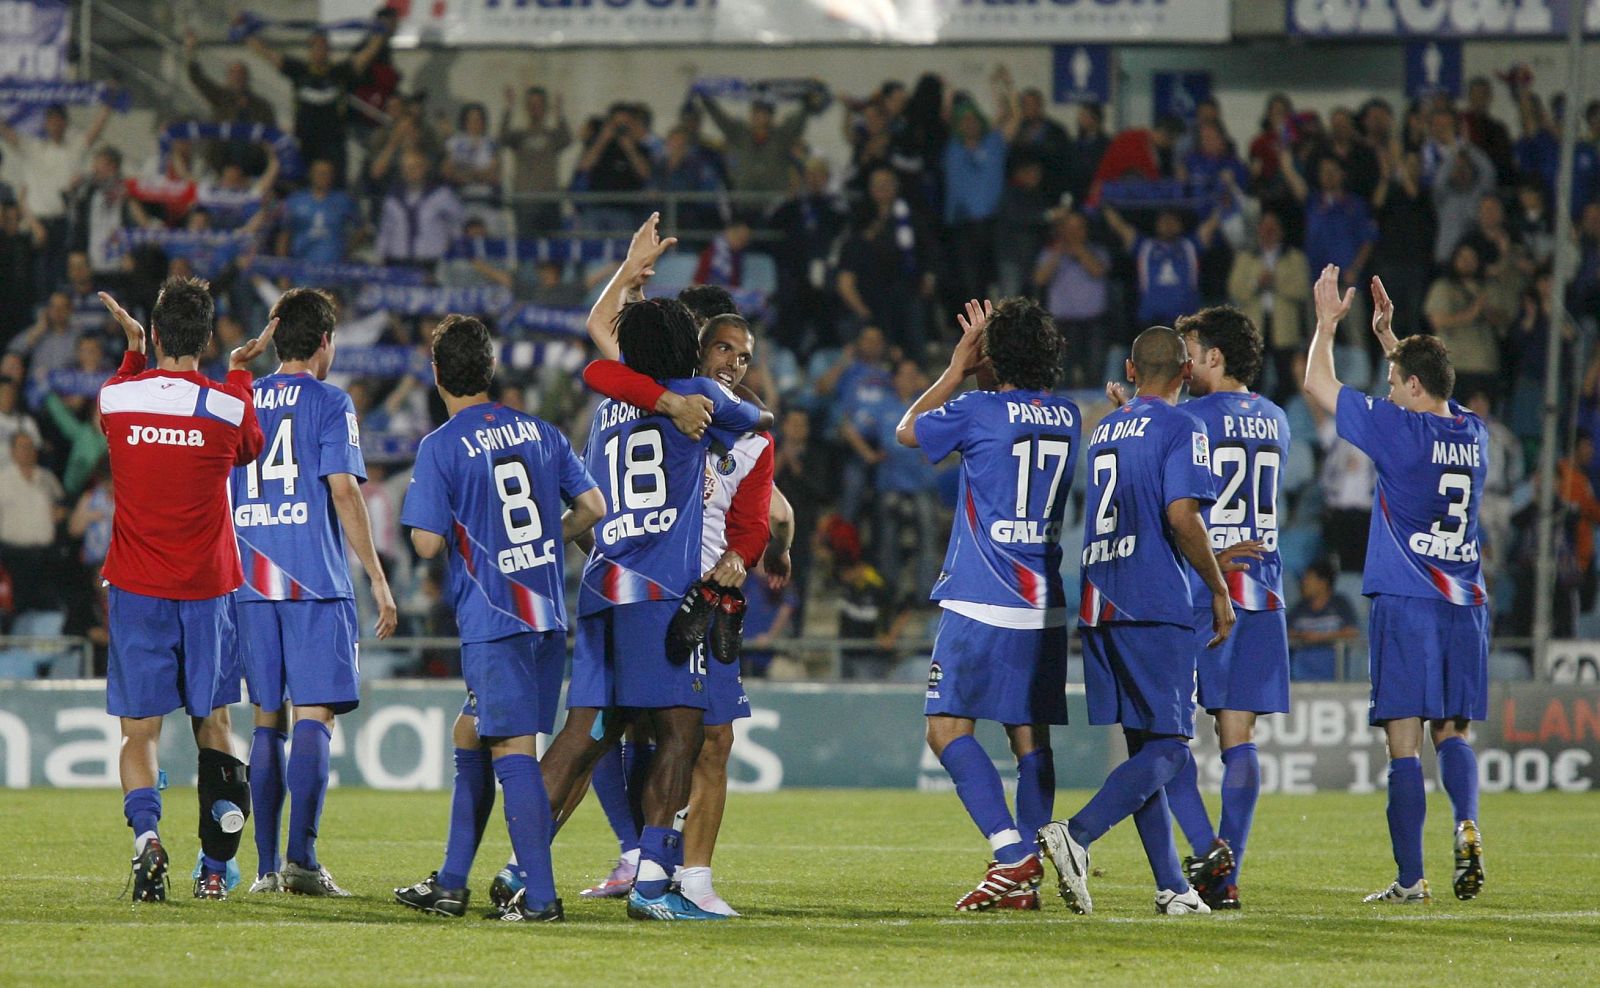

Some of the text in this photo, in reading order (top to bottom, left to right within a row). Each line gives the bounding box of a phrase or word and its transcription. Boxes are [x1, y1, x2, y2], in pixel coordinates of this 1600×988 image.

[253, 386, 301, 409] MANU
[1007, 401, 1073, 427] PAREJO
[1111, 417, 1151, 441] DIAZ
[1431, 437, 1480, 467] MANÉ
[604, 429, 667, 513] 18
[1012, 440, 1069, 519] 17
[1094, 454, 1118, 535] 2
[1210, 447, 1280, 529] 20
[235, 502, 308, 527] GALCO
[494, 461, 543, 545] 8
[602, 508, 677, 545] GALCO
[1430, 473, 1471, 546] 3
